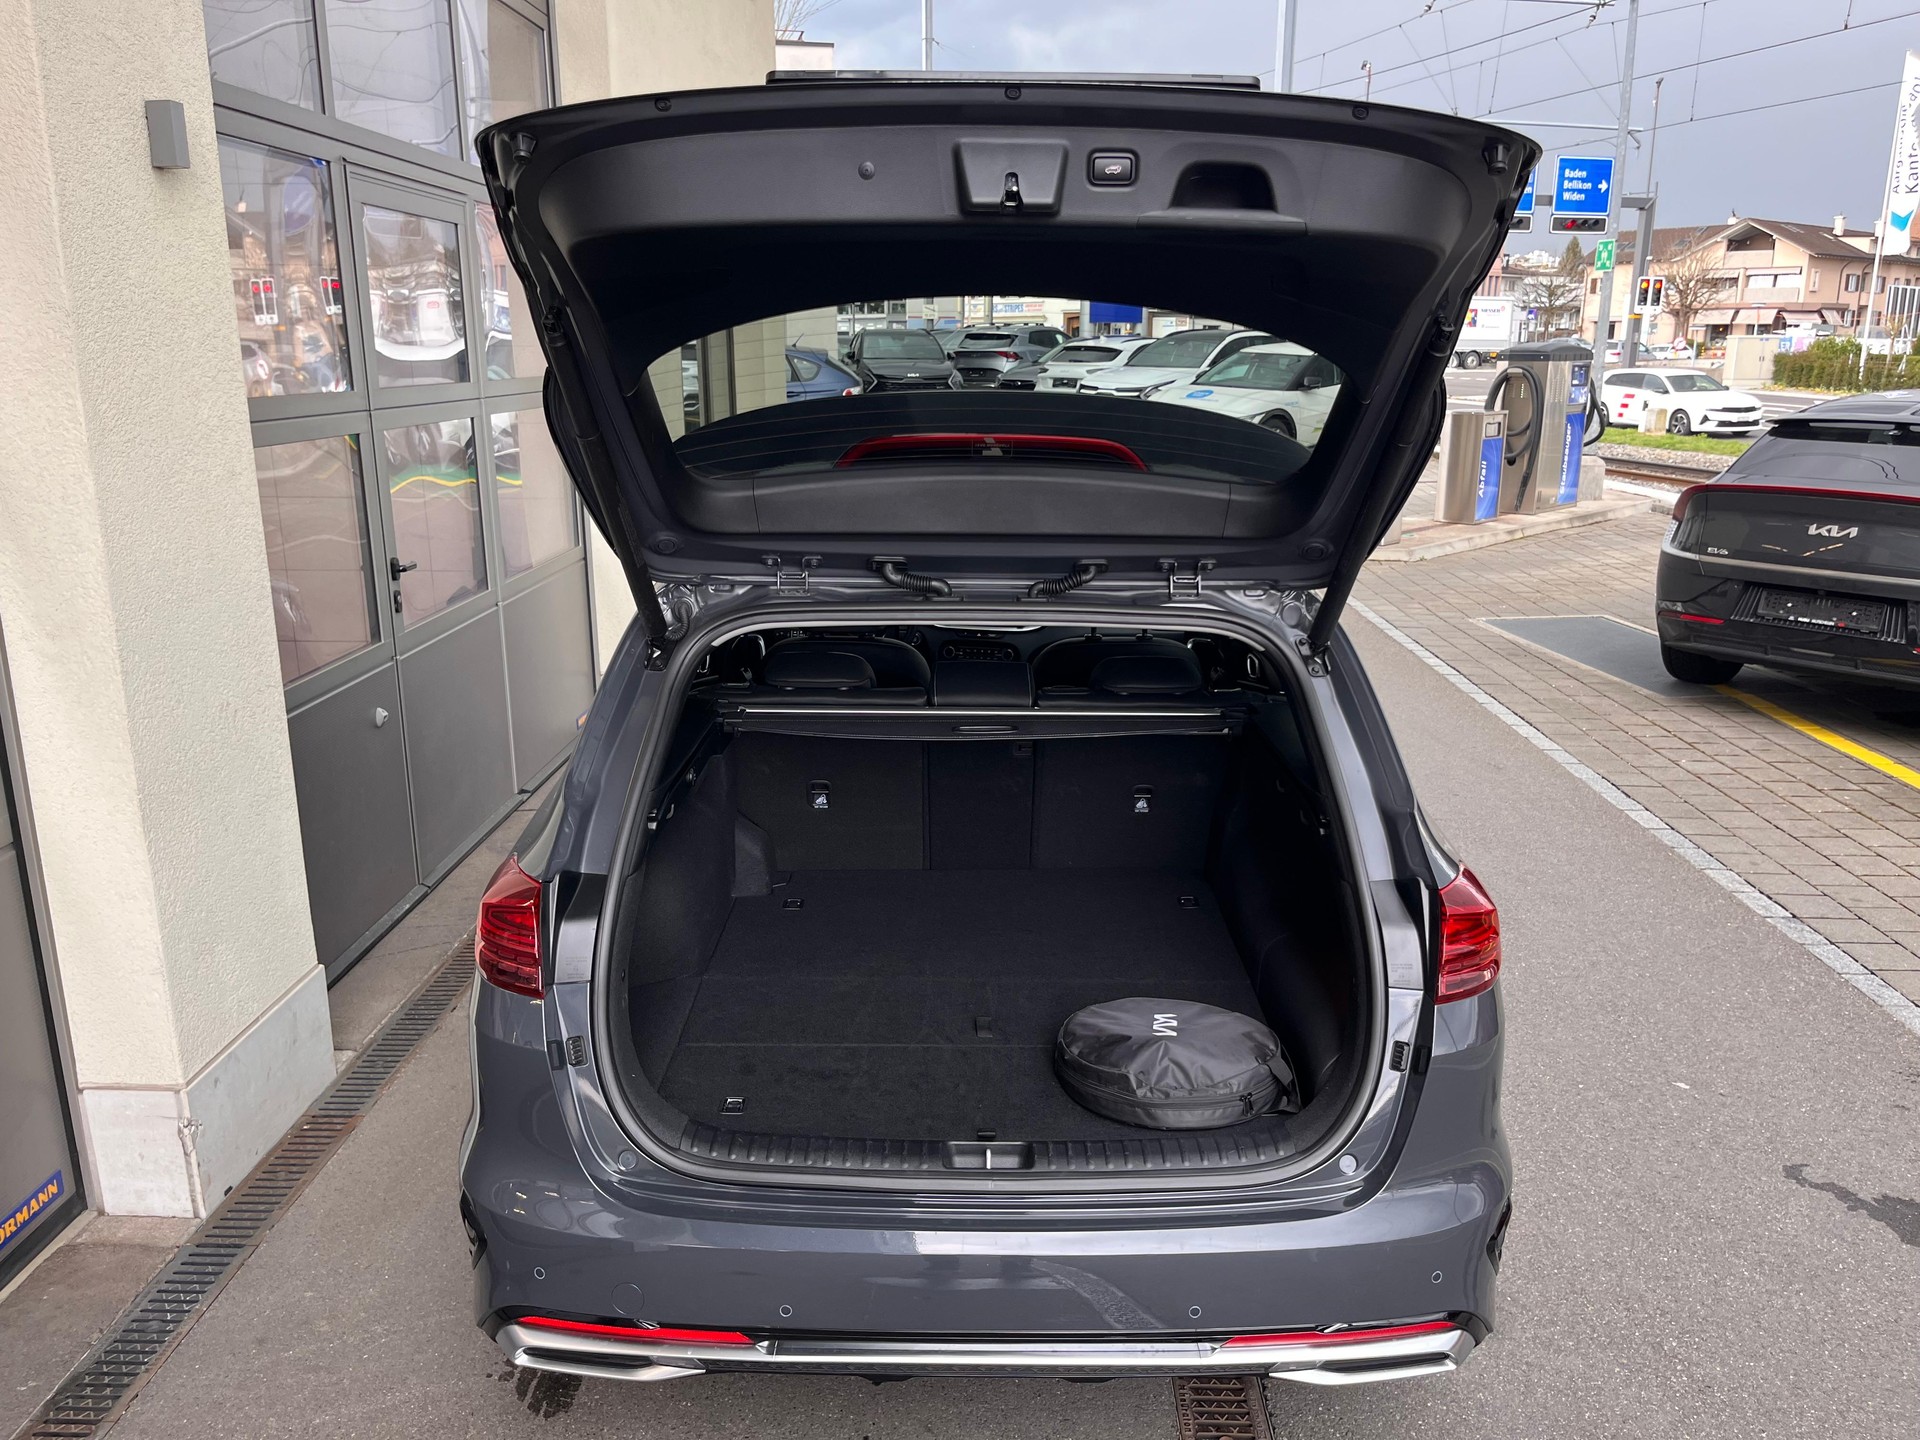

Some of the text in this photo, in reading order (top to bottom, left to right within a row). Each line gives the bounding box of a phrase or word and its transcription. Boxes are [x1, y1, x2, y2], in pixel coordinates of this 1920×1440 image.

[1564, 168, 1587, 178] Baden
[1563, 180, 1592, 190] Bellikon
[1563, 191, 1585, 201] Widen
[1559, 423, 1572, 495] Staubsauger
[1478, 460, 1487, 498] Abfall
[1808, 523, 1858, 539] KIA
